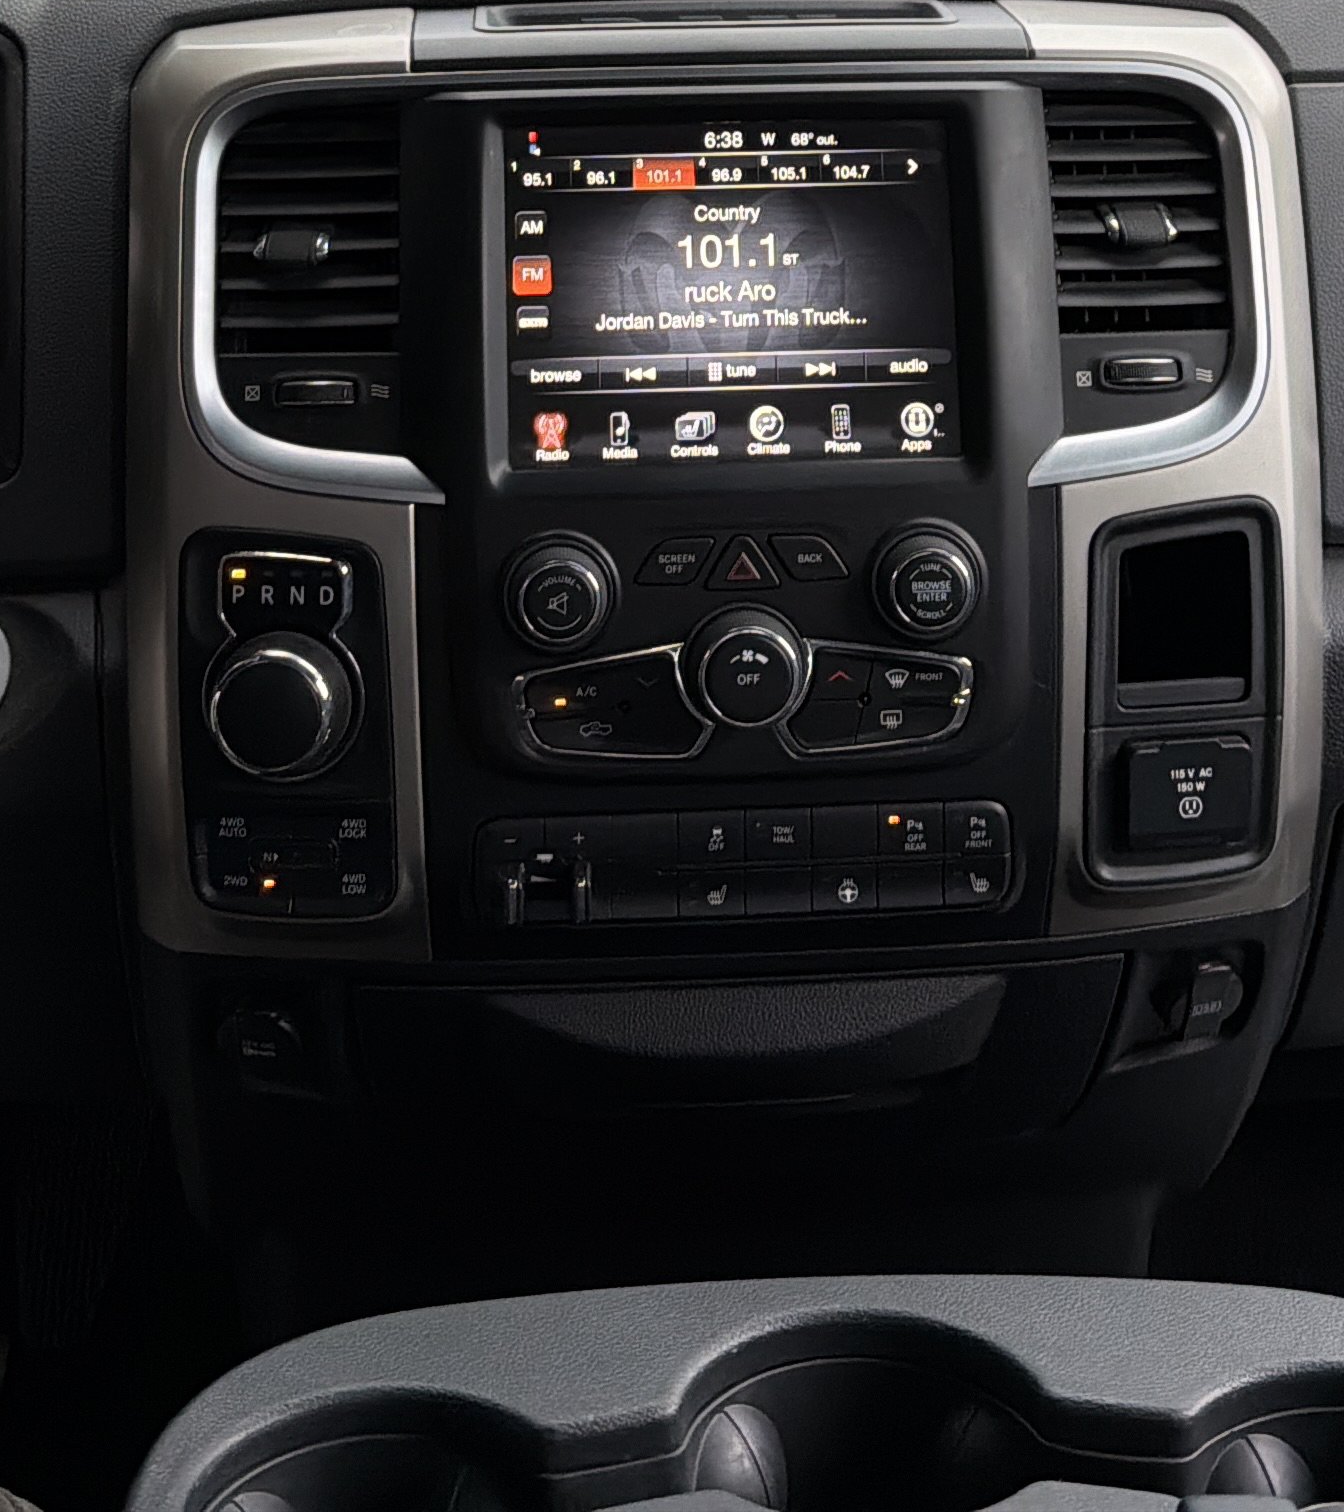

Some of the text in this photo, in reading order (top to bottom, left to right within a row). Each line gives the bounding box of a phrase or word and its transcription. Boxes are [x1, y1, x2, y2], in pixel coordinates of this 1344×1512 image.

[704, 131, 743, 149] 6:38
[761, 132, 776, 146] W
[523, 172, 553, 187] 95.1
[586, 171, 616, 185] 96.1
[646, 169, 682, 183] 101.1
[711, 168, 743, 182] 96.9
[771, 166, 807, 181] 105.1
[833, 165, 870, 180] 104.7
[694, 204, 761, 224] Country
[520, 220, 544, 235] AM
[677, 233, 778, 269] 101.1
[522, 267, 544, 283] FM
[685, 280, 776, 303] ruck Aro
[595, 312, 654, 332] Jordan
[658, 311, 705, 329] Davis
[720, 310, 760, 328] Turn
[763, 308, 799, 327] This
[726, 363, 756, 378] tune
[889, 358, 928, 375] audio
[530, 368, 582, 384] browse
[602, 446, 638, 459] Media
[670, 444, 719, 458] Controls
[747, 441, 791, 455] Climate
[824, 440, 862, 454] Phone
[901, 438, 933, 453] Apps
[536, 447, 570, 462] Radio
[658, 552, 696, 565] SCREEN
[798, 552, 823, 564] BACK
[665, 563, 684, 574] OFF
[919, 562, 942, 572] TUNE
[542, 574, 578, 588] VOLUME
[911, 579, 952, 590] BROWSE
[232, 585, 335, 606] P R N D
[916, 592, 948, 603] ENTER
[736, 673, 760, 686] OFF
[576, 685, 598, 698] A/C
[1170, 767, 1213, 780] 115 V AC
[1177, 781, 1206, 793] 150 W
[219, 817, 245, 827] 4WD
[341, 818, 367, 829] 4WD
[218, 827, 247, 838] AUTO
[339, 828, 367, 839] LOCK
[904, 842, 927, 852] REAR
[223, 875, 248, 887] 2WD
[341, 873, 367, 884] 4WD
[342, 884, 367, 895] LOW
